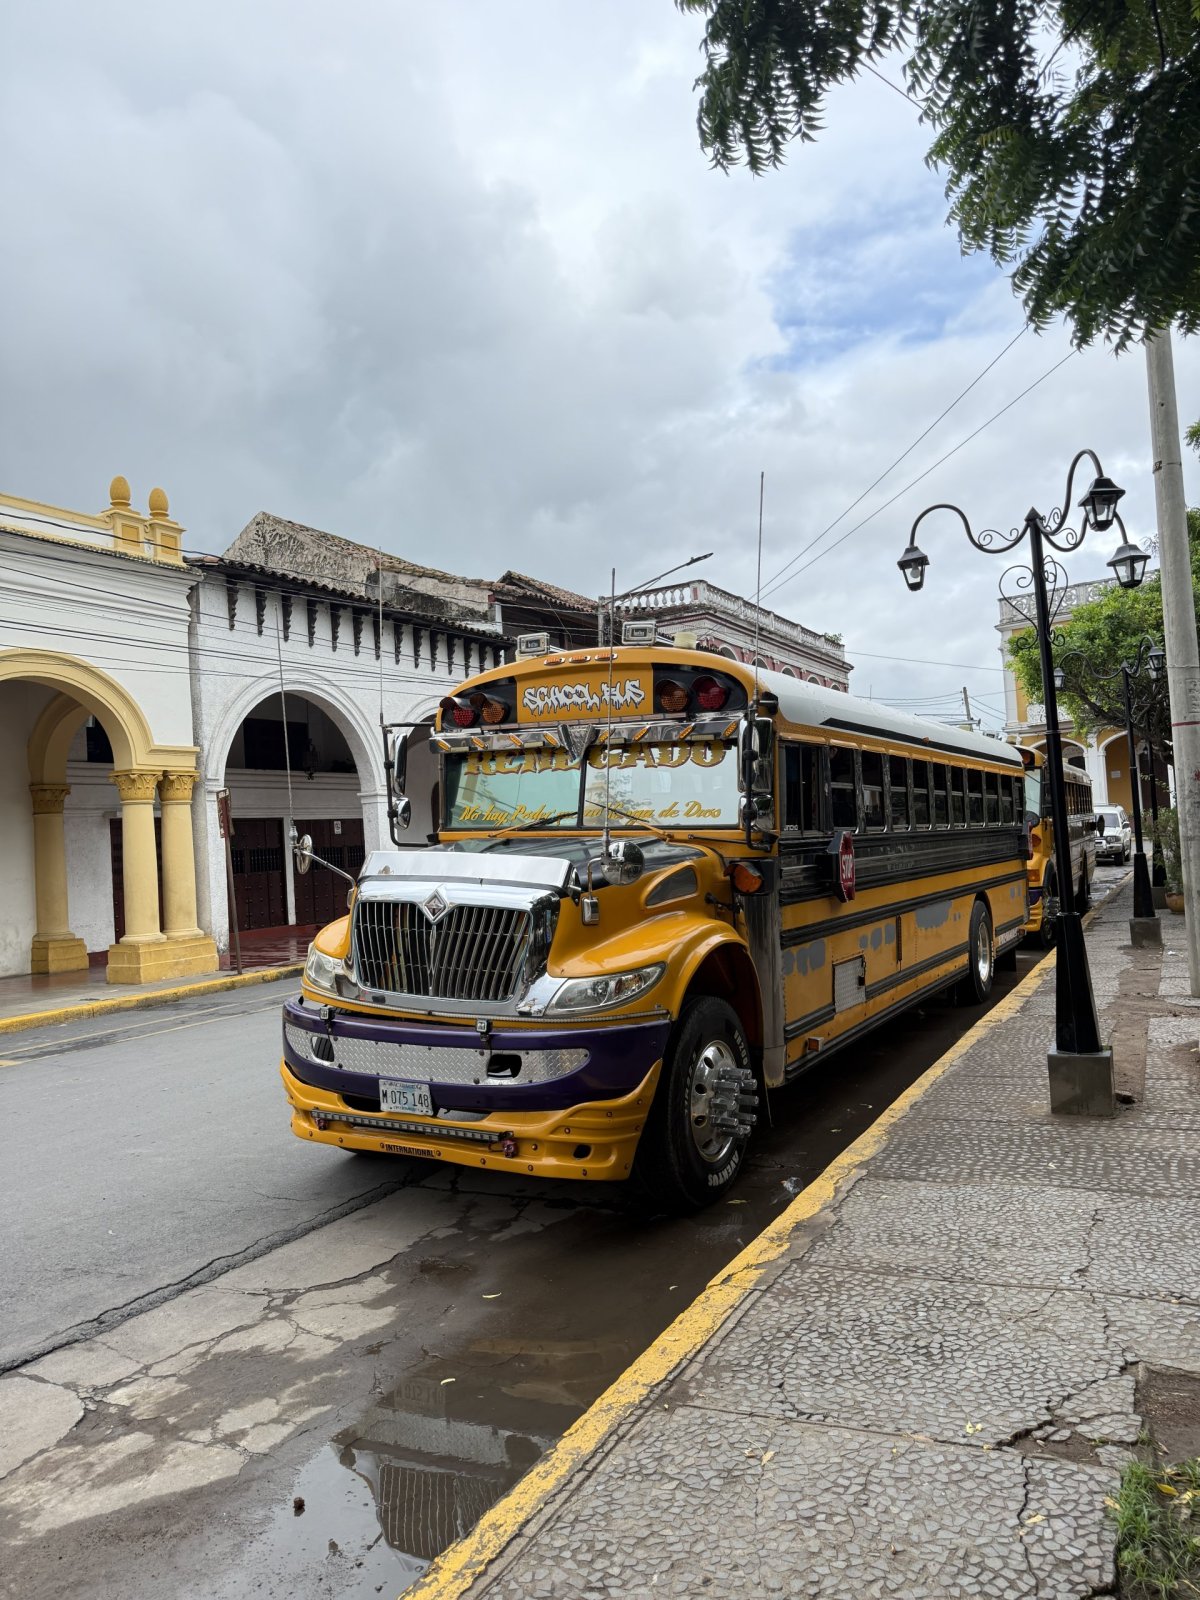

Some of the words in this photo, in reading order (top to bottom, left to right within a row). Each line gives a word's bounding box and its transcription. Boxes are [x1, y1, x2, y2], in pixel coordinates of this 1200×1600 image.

[523, 683, 601, 716] SCHOOL
[601, 678, 645, 711] BUS
[459, 804, 482, 822] No
[657, 801, 680, 818] de
[841, 854, 853, 880] STOP
[382, 1089, 388, 1104] M
[390, 1090, 408, 1106] 075
[412, 1093, 429, 1108] 148
[385, 1143, 434, 1158] INTERNATIONAL
[707, 1150, 739, 1187] AVENTUS
